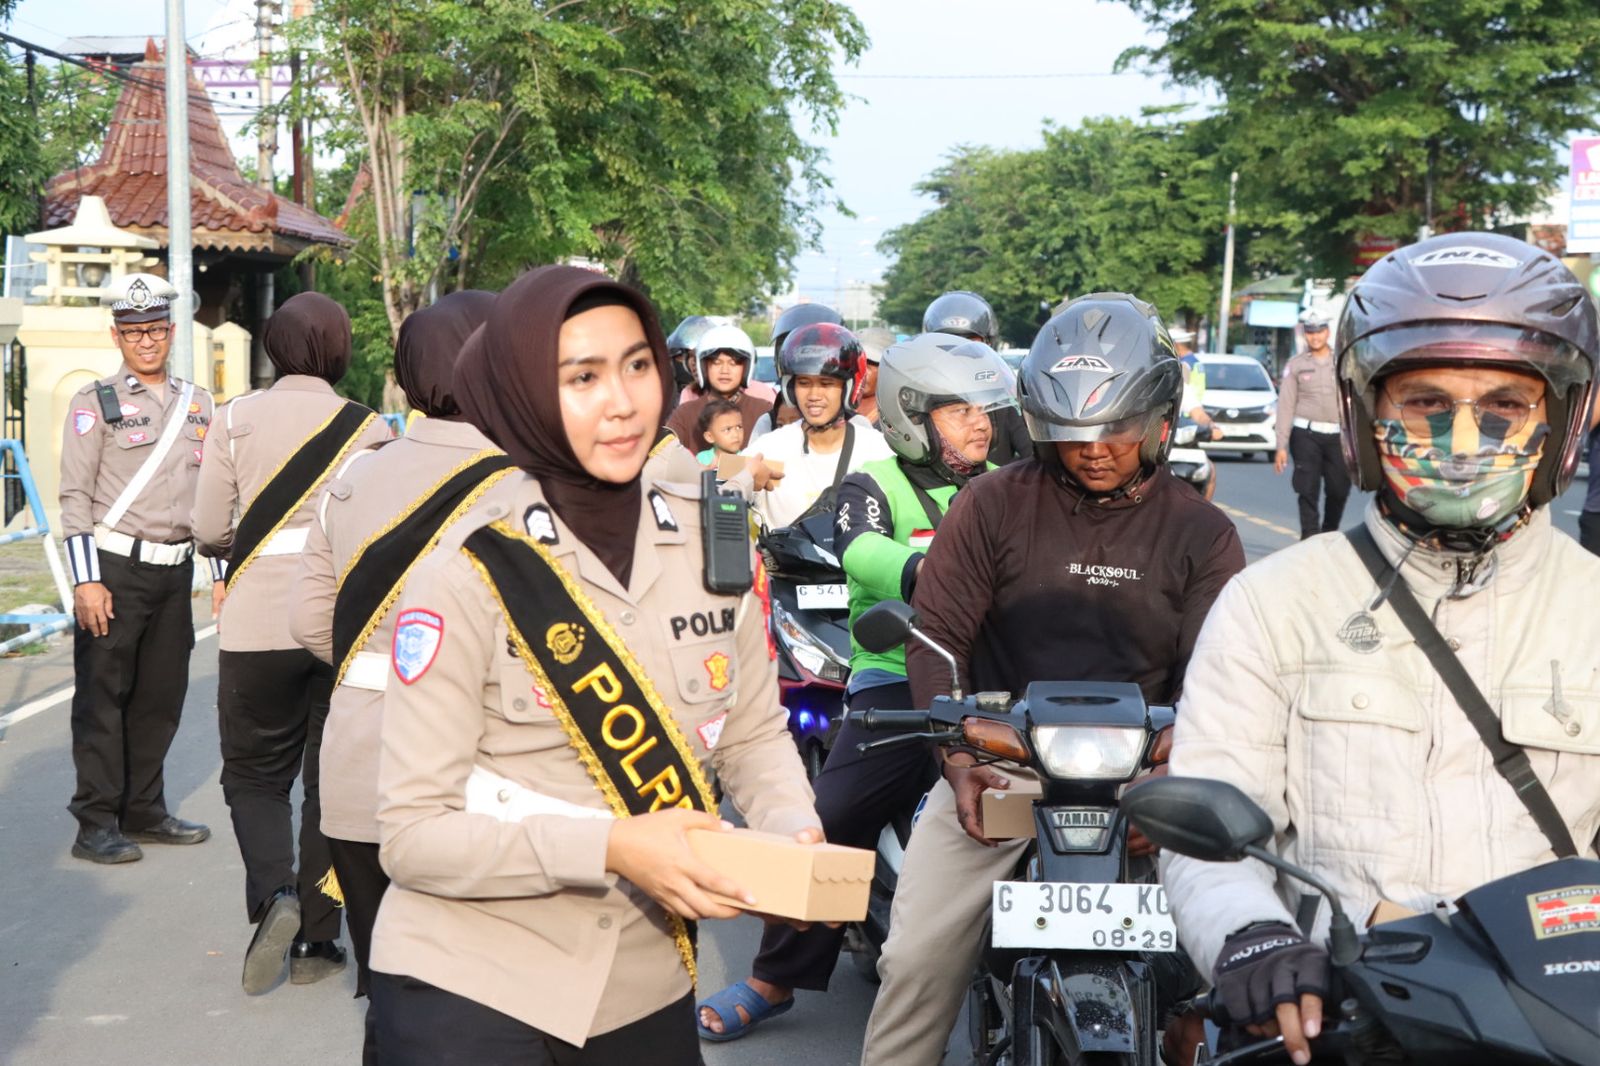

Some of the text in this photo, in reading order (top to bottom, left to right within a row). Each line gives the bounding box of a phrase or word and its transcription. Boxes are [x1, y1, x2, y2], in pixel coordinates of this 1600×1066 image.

[1423, 250, 1504, 263] INK
[1056, 812, 1106, 826] YAMAHA
[998, 884, 1013, 913] G
[1039, 883, 1113, 915] 3064
